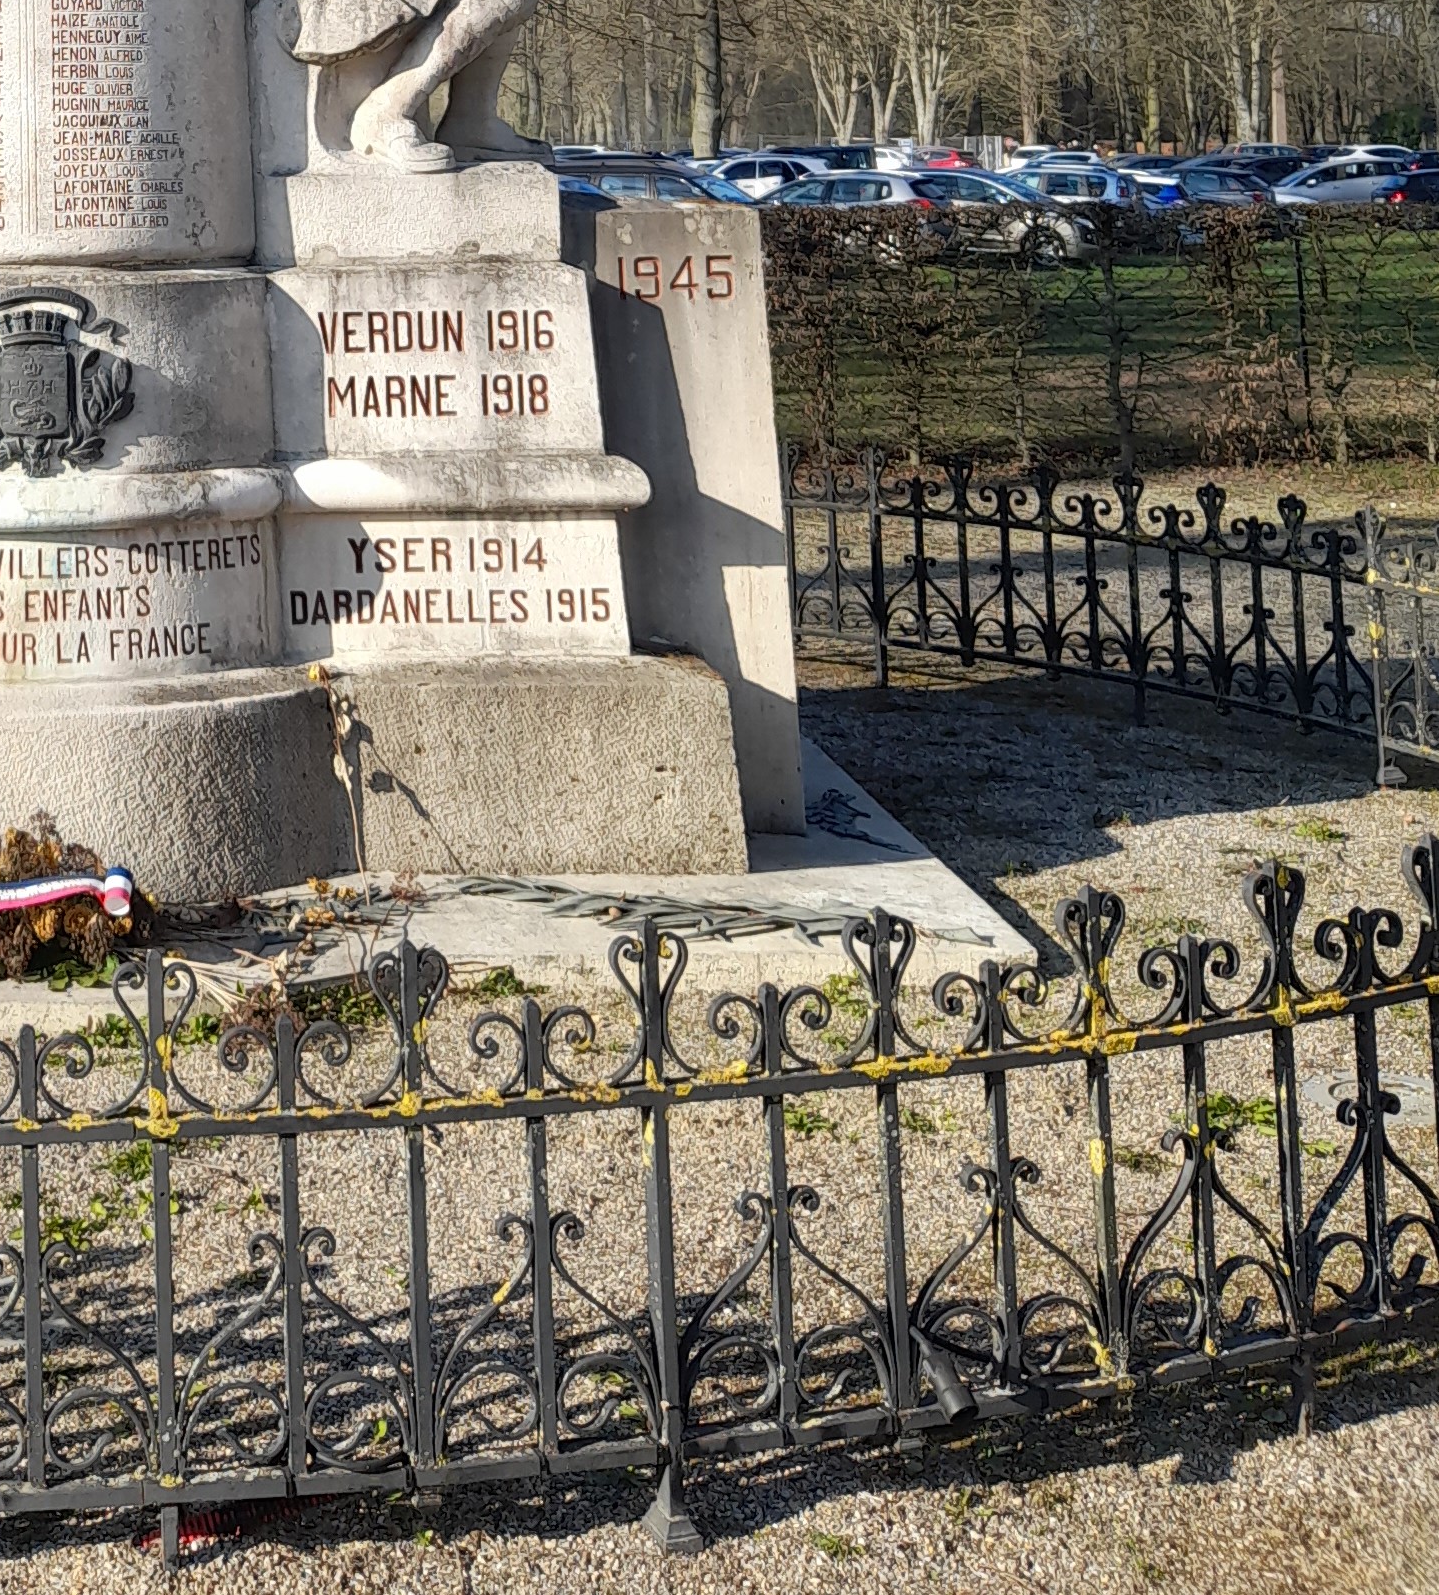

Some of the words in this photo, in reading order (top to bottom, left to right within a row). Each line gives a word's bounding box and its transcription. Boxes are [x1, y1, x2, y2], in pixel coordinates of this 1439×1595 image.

[111, 0, 144, 11] VICTOR
[52, 14, 88, 26] HAIZE
[96, 16, 139, 28] ANATOLE
[52, 30, 120, 44] HENNEGUY
[126, 33, 148, 43] AIME
[52, 47, 96, 61] HENON
[104, 50, 142, 61] ALFRED
[52, 64, 98, 78] HERBIN
[105, 66, 133, 78] LOUIS
[53, 82, 87, 96] HUGE
[95, 84, 133, 96] OLIVIER
[53, 98, 100, 111] HUGNIN
[108, 100, 149, 111] MAURICE
[124, 117, 148, 127] JEAN
[54, 131, 131, 145] JEAN-MARIE
[141, 133, 178, 143] ACHILLE
[54, 148, 123, 161] JOSSEAUX
[131, 150, 168, 160] ERNEST
[54, 164, 107, 178] JOYEUX
[116, 166, 144, 177] LOUIS
[54, 179, 133, 194] LAFONTAINE
[141, 182, 183, 192] CHARLES
[55, 196, 134, 211] LAFONTAINE
[142, 199, 167, 209] LOUIS
[55, 214, 125, 228] LANGELOT
[132, 216, 168, 226] ALFRED
[618, 255, 734, 301] 1945
[318, 310, 463, 354] VERDUN
[487, 310, 554, 351] 1916
[328, 375, 457, 417] MARNE
[481, 374, 548, 416] 1918
[347, 538, 452, 573] YSER
[470, 537, 547, 572] 1914
[25, 585, 150, 622] ENFANTS
[290, 589, 528, 625] DARDANELLES
[546, 588, 610, 623] 1915
[57, 632, 90, 663] LA
[111, 623, 211, 661] FRANCE
